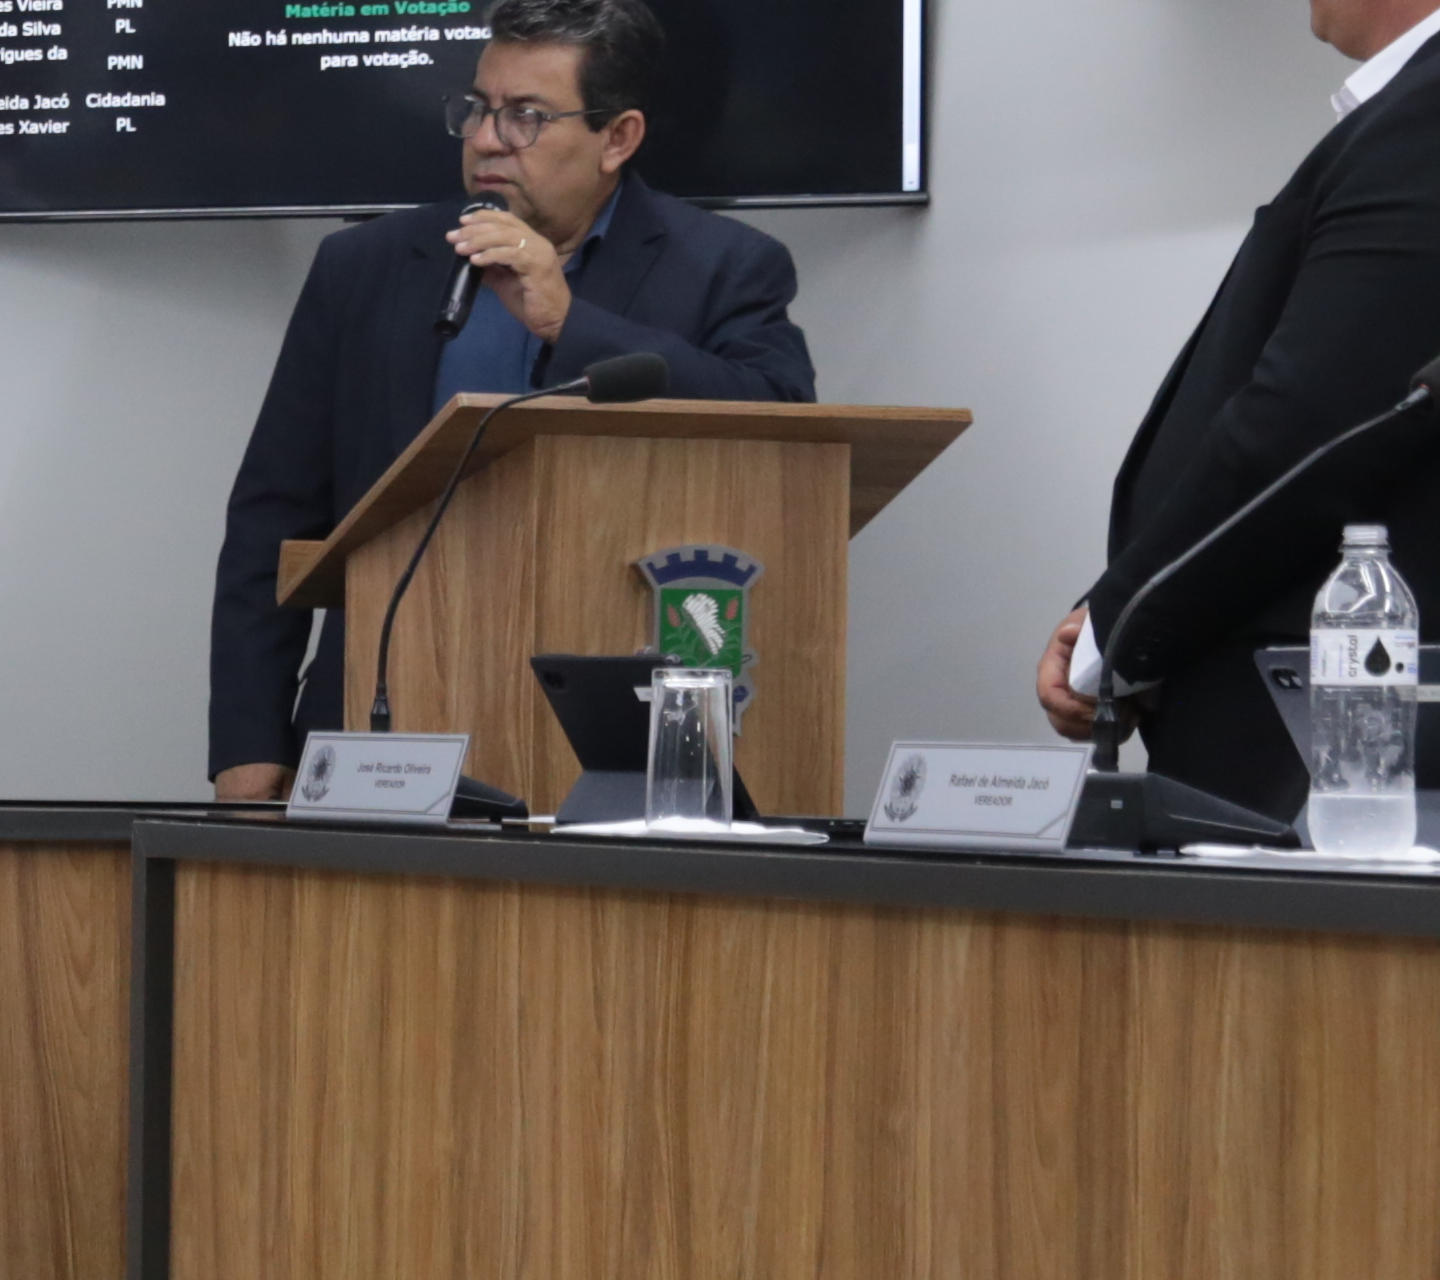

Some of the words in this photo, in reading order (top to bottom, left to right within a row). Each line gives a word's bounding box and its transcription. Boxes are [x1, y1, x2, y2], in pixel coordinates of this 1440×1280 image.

[286, 2, 355, 18] Matéria
[360, 4, 389, 16] em
[22, 21, 61, 36] Silva
[116, 19, 136, 33] PL
[229, 31, 261, 46] Não
[266, 29, 287, 45] há
[292, 29, 370, 44] nenhuma
[375, 25, 440, 42] matéria
[444, 25, 492, 40] vota
[47, 45, 68, 60] da
[321, 55, 358, 70] para
[363, 50, 433, 68] votação.
[108, 55, 143, 70] PMN
[34, 93, 70, 109] Jacó
[86, 92, 165, 108] Cidadania
[19, 120, 70, 134] Xavier
[116, 117, 136, 132] PL
[1347, 635, 1360, 677] crystal
[358, 762, 374, 773] José
[949, 775, 976, 787] Rafael
[978, 776, 989, 788] de
[991, 776, 1026, 789] Almeida
[1027, 777, 1049, 790] Jacó
[975, 795, 1013, 806] VEREADOR
